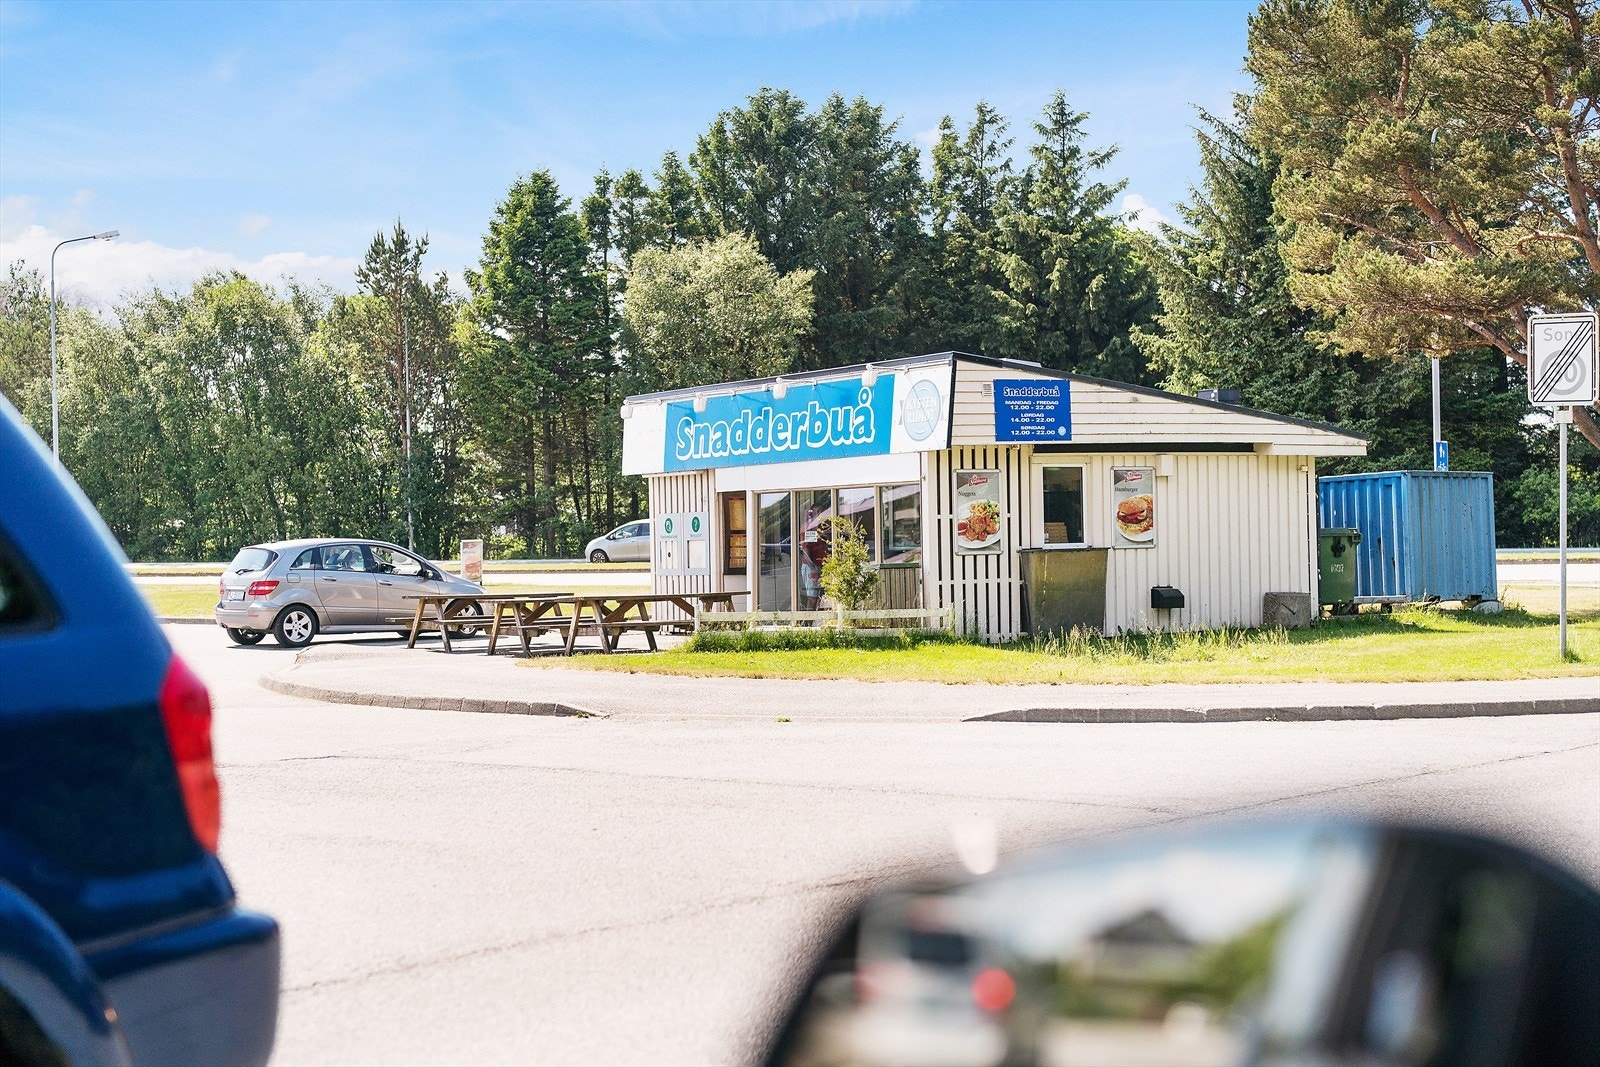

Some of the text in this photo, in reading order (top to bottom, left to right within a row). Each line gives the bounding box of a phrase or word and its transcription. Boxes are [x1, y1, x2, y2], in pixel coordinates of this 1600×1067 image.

[1544, 328, 1580, 342] Son
[1003, 385, 1060, 397] Snadderbuå
[906, 397, 937, 410] KYSTEN
[675, 386, 876, 461] Snadderbuå
[957, 490, 977, 498] Nuggets
